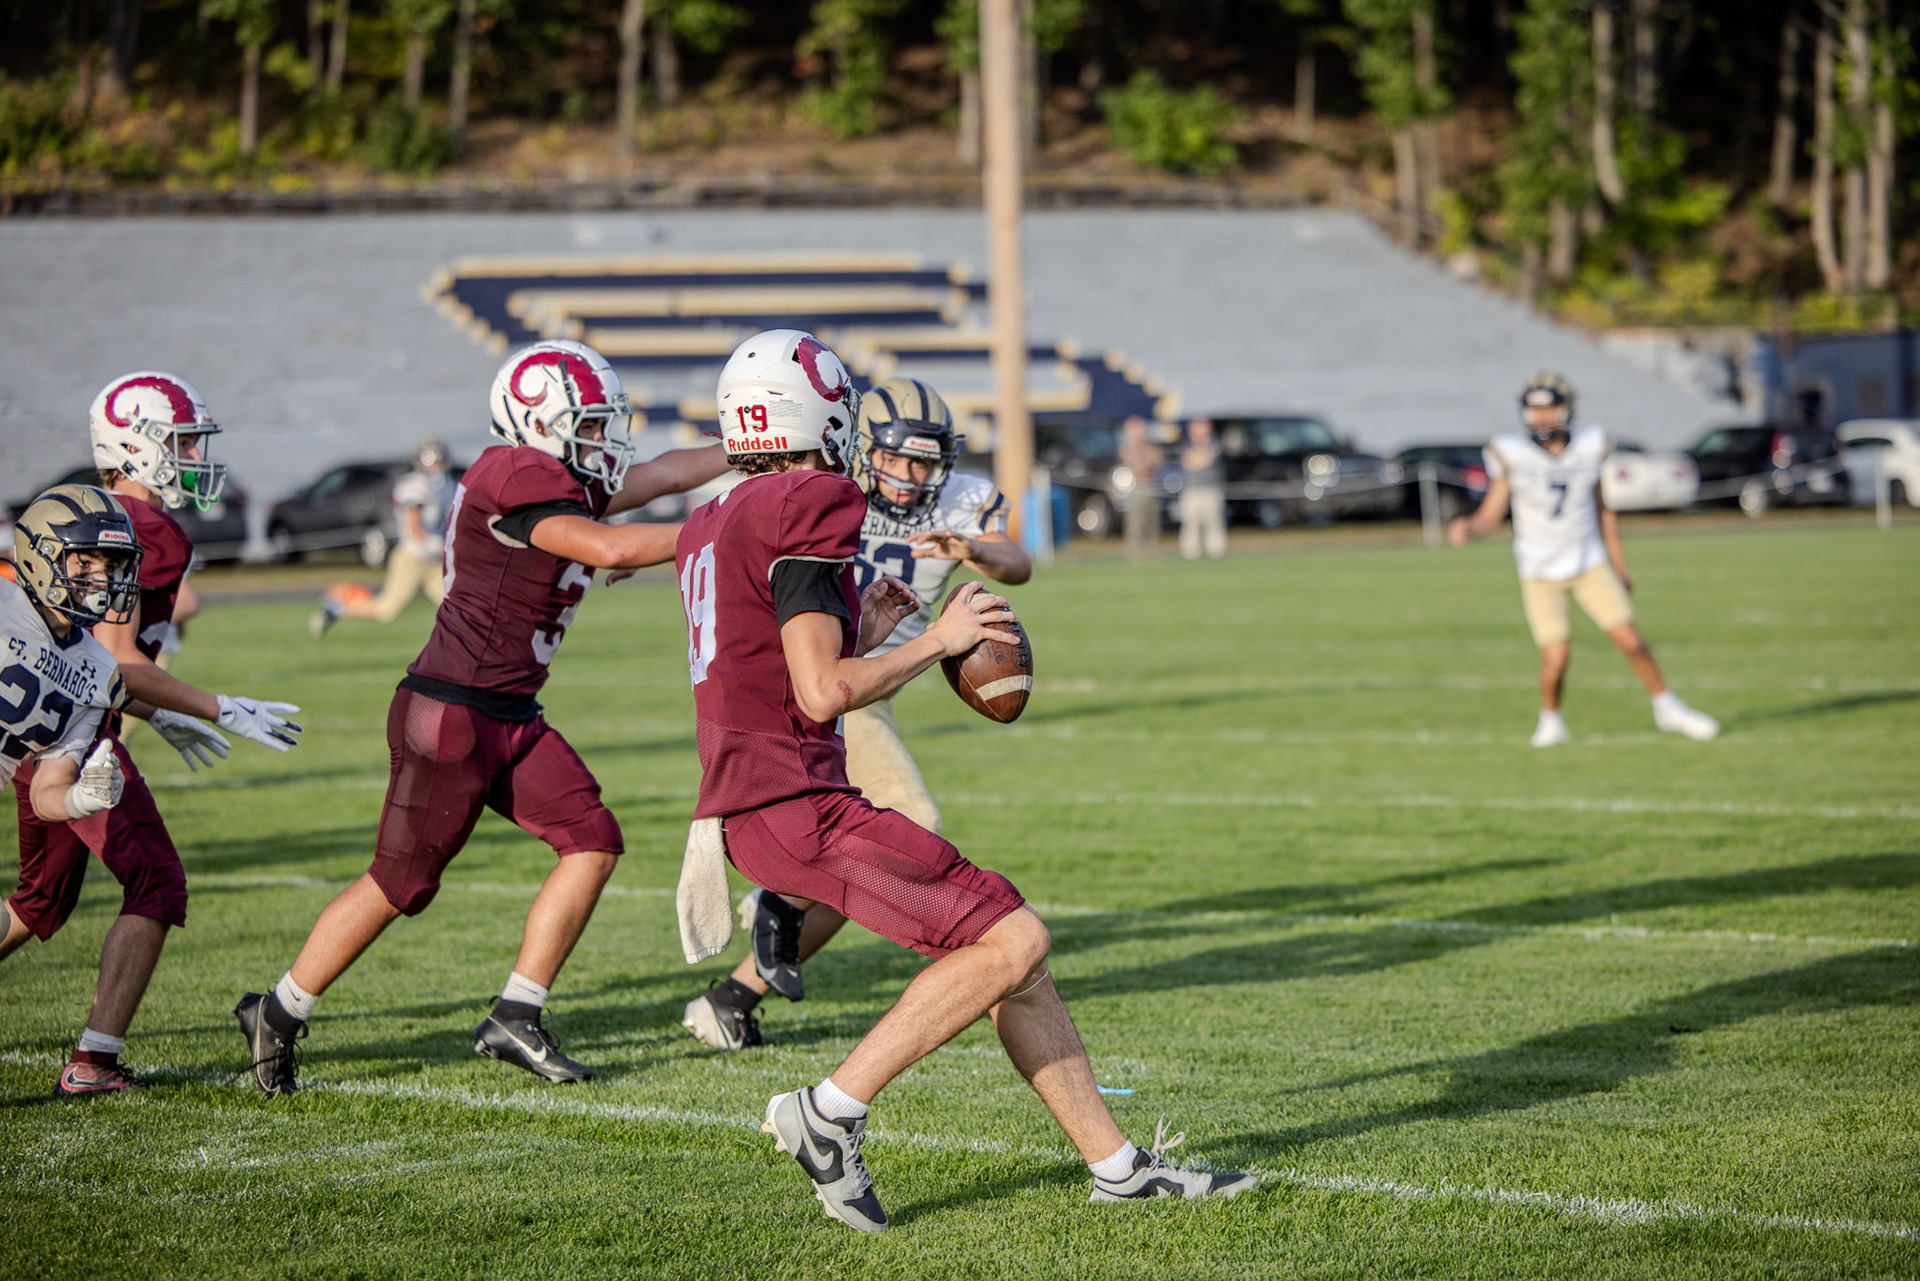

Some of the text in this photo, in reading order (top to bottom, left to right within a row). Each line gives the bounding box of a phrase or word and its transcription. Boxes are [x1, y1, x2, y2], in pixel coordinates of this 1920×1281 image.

[737, 404, 768, 434] 19
[727, 436, 788, 453] Riddell
[1549, 482, 1568, 517] 7
[680, 541, 718, 691] 19
[34, 647, 97, 705] BERNARD'S
